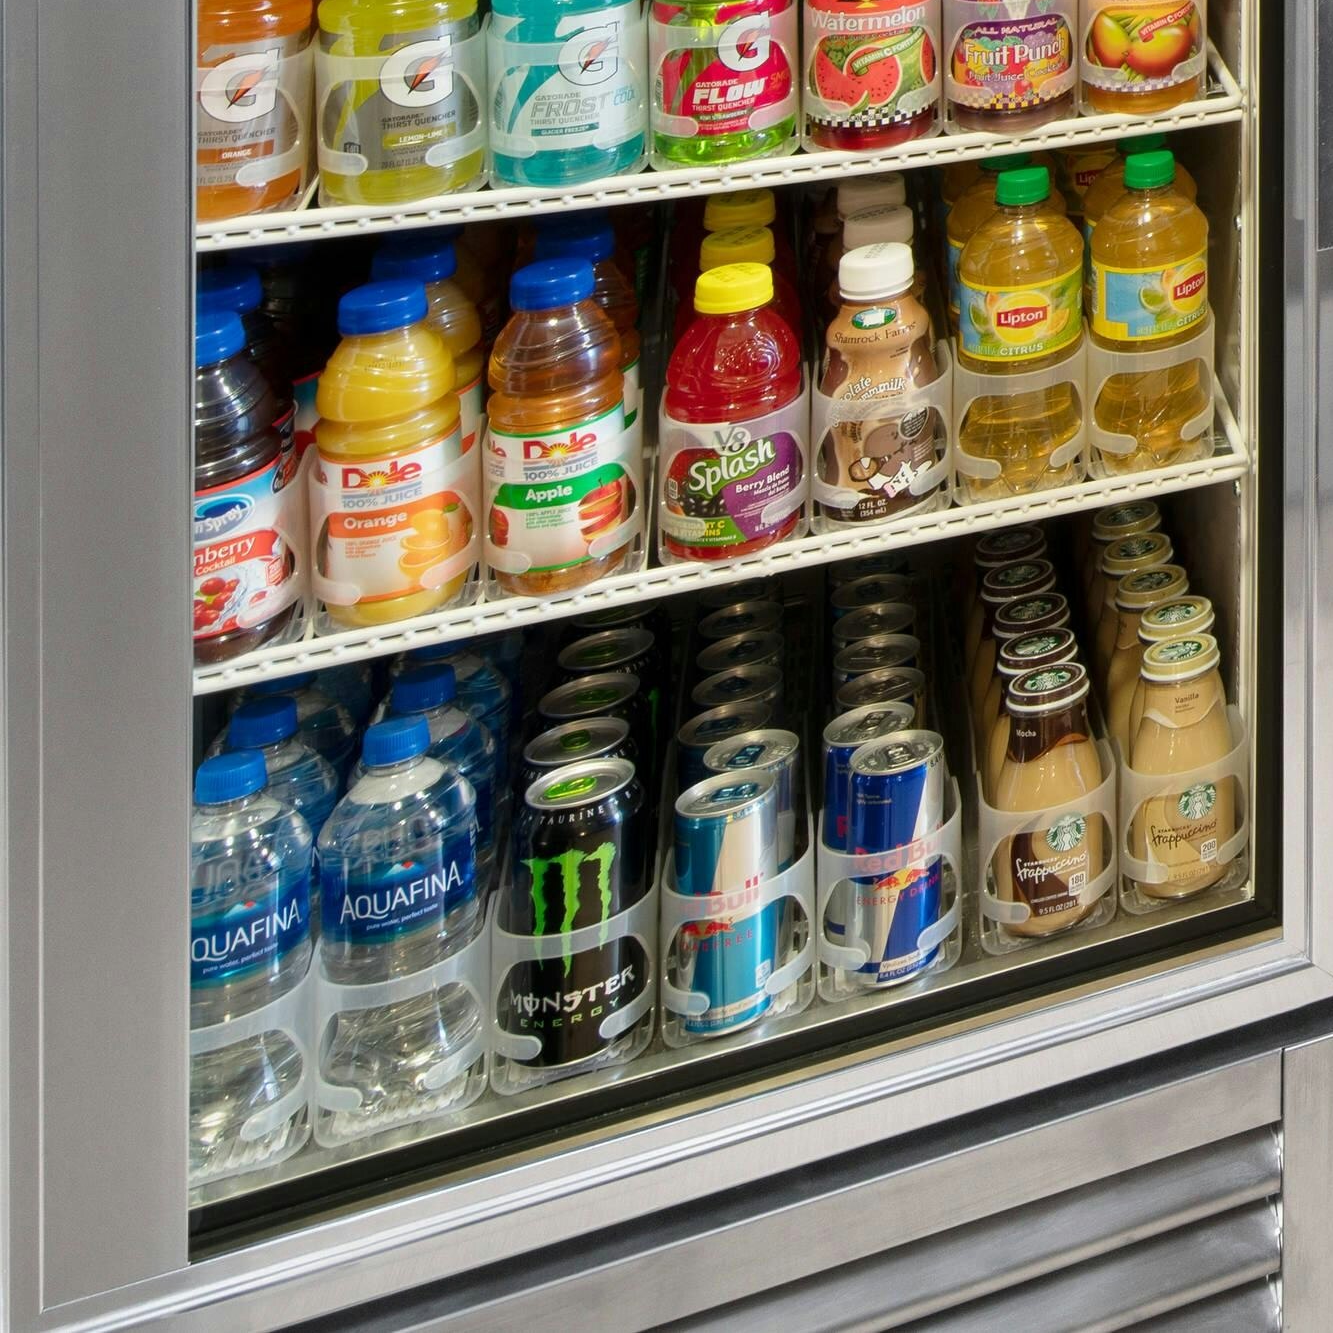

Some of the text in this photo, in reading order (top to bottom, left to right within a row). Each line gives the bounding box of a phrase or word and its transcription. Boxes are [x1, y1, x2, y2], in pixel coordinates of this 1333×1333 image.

[811, 6, 926, 32] Watermelon
[964, 33, 1065, 66] Fruit Punch
[853, 50, 884, 70] VITAMIN
[692, 79, 765, 104] FLOW
[695, 79, 739, 89] GATORADE
[530, 92, 612, 118] FROST
[534, 92, 581, 102] GATORADE
[692, 98, 756, 112] THIRST QUENCHER
[411, 110, 456, 127] QUENCHER
[530, 118, 560, 127] THIRST
[399, 129, 444, 143] LEMON-LIME
[221, 148, 252, 159] ORANGE
[1000, 309, 1044, 326] Lipton
[834, 332, 882, 345] Shamrock
[1000, 342, 1043, 356] CITRUS
[522, 432, 597, 465] Dole
[341, 460, 422, 491] Dole
[523, 456, 598, 482] 100% JUICE
[688, 437, 777, 495] Splash
[735, 464, 790, 494] Berry Blend
[341, 486, 423, 509] 100% JUICE
[525, 483, 573, 502] Apple
[205, 507, 243, 533] Spray
[343, 511, 408, 530] Orange
[1175, 693, 1199, 704] Vanilla
[1016, 729, 1036, 738] Mocha
[540, 804, 605, 826] TAURINE
[1151, 821, 1217, 848] frappuccino
[1202, 841, 1216, 852] 200
[1016, 852, 1086, 884] frappuccino
[1071, 874, 1084, 885] 180
[856, 889, 905, 906] ENERGY
[190, 898, 303, 963] QUAFINA
[509, 963, 636, 1019] MONSTER
[519, 996, 619, 1029] ENERGY
